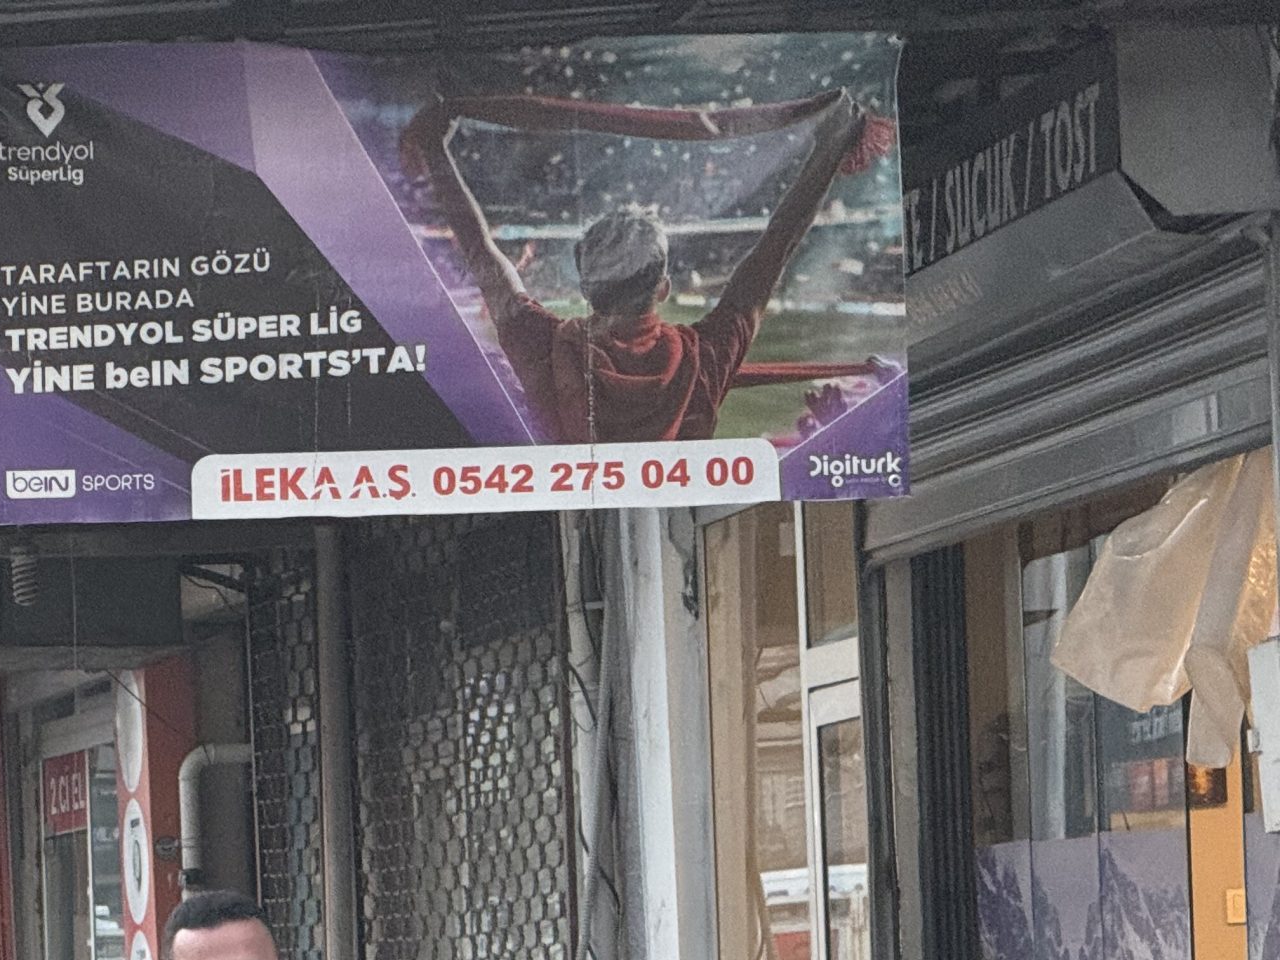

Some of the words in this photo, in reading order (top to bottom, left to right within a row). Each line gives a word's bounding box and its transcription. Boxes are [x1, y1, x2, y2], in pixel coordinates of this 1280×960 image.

[8, 166, 84, 185] SüperLig
[945, 133, 1017, 255] SUCUK
[1040, 82, 1100, 199] TOST
[1, 257, 181, 286] TARAFTARIN
[191, 247, 271, 277] GÖZÜ
[2, 291, 67, 317] YİNE
[77, 287, 195, 313] BURADA
[5, 322, 184, 352] TRENDYOL
[192, 313, 301, 342] SÜPER
[310, 306, 362, 336] LİG
[6, 362, 95, 394] YİNE
[105, 359, 189, 390] beIN
[12, 472, 70, 493] beIN
[82, 473, 155, 493] SPORTS
[221, 466, 342, 502] İLEKA
[433, 464, 536, 495] 0542
[550, 461, 625, 492] 275
[641, 459, 690, 489] 04
[705, 456, 755, 486] 00
[809, 451, 902, 487] Digiturk
